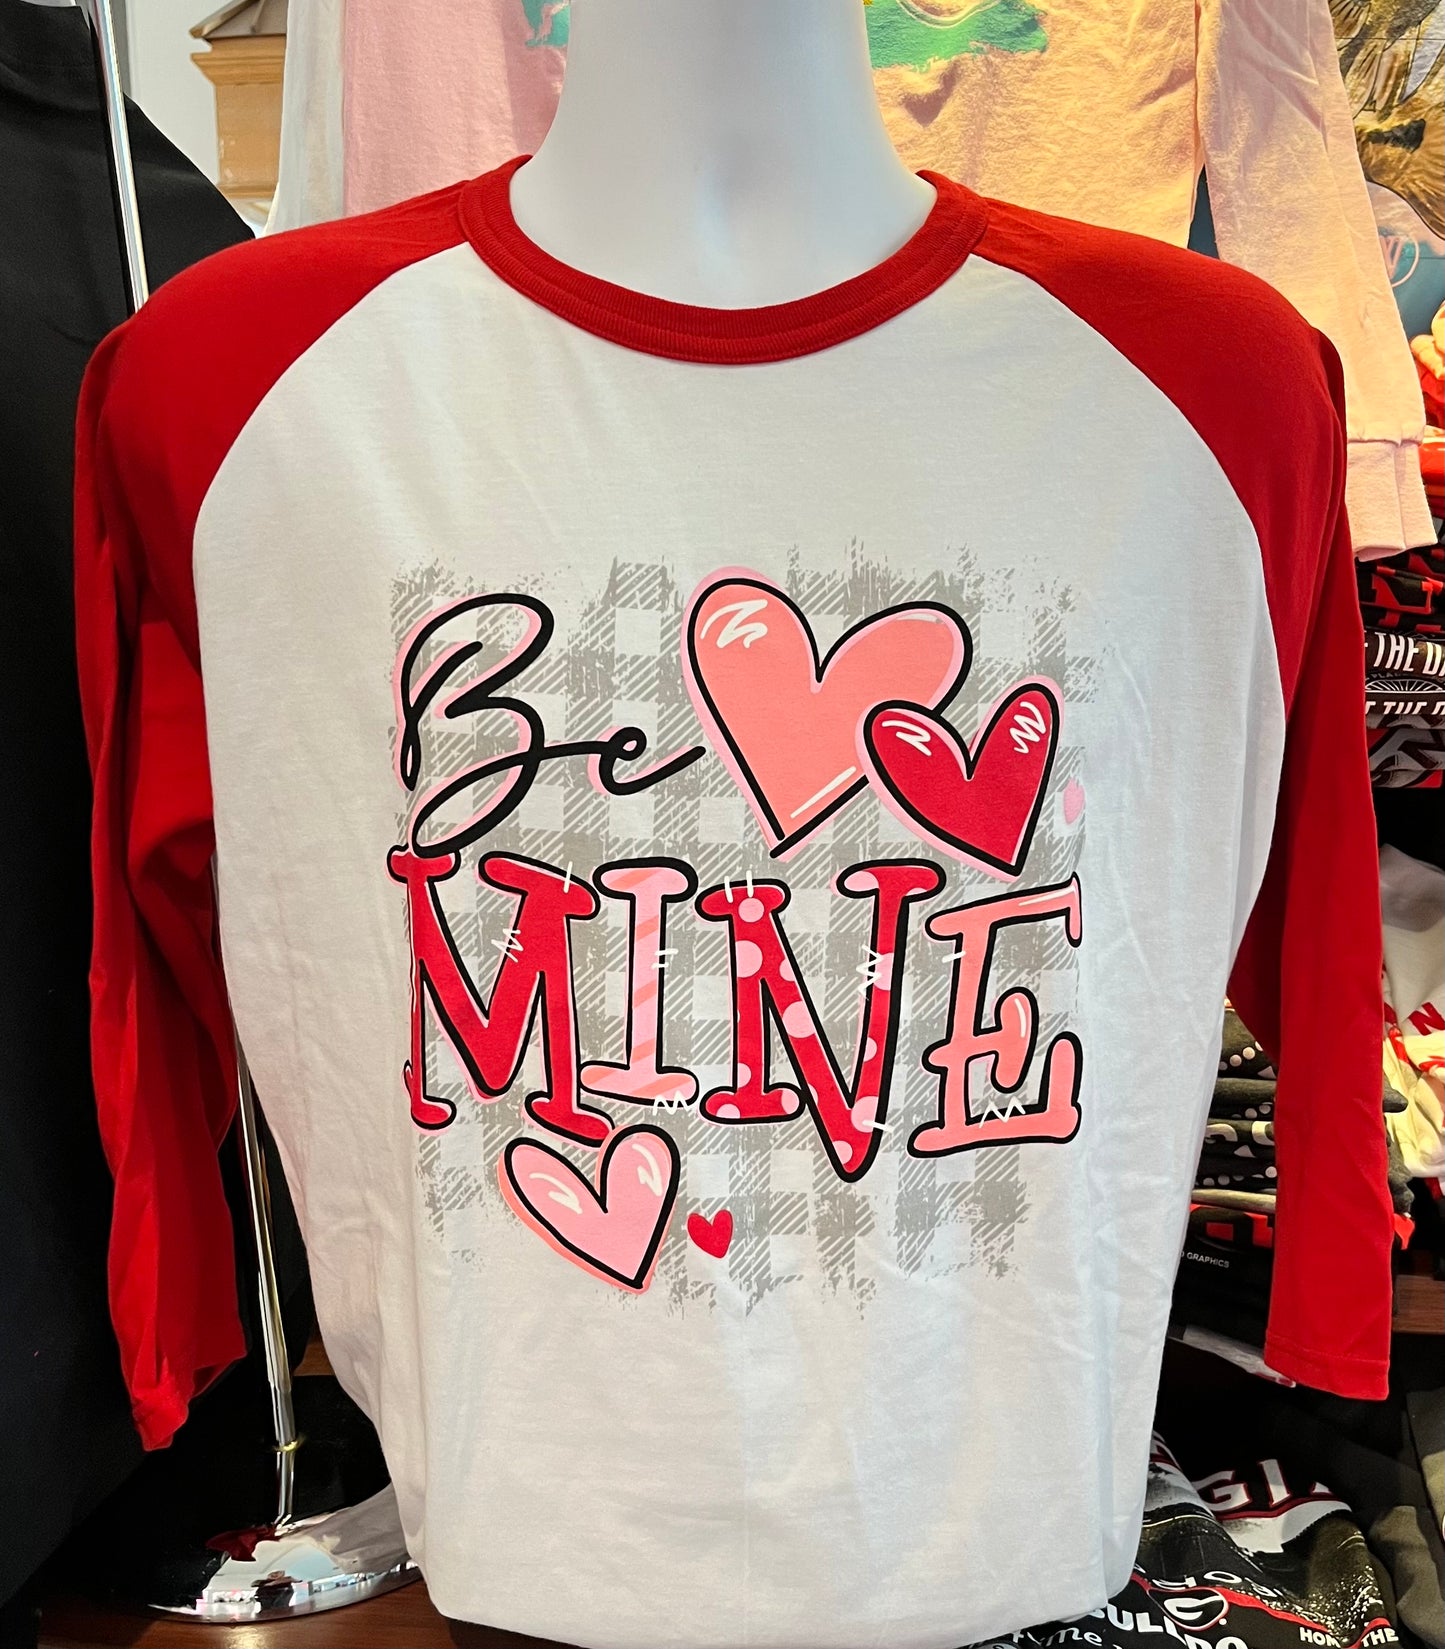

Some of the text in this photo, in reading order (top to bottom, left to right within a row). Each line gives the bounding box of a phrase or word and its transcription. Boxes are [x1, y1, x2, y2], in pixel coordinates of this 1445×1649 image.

[1373, 631, 1420, 672] THE
[399, 593, 707, 859] Be
[387, 845, 1084, 1182] MINE
[1186, 1251, 1230, 1269] GRAPHICS
[1360, 1627, 1400, 1648] THE
